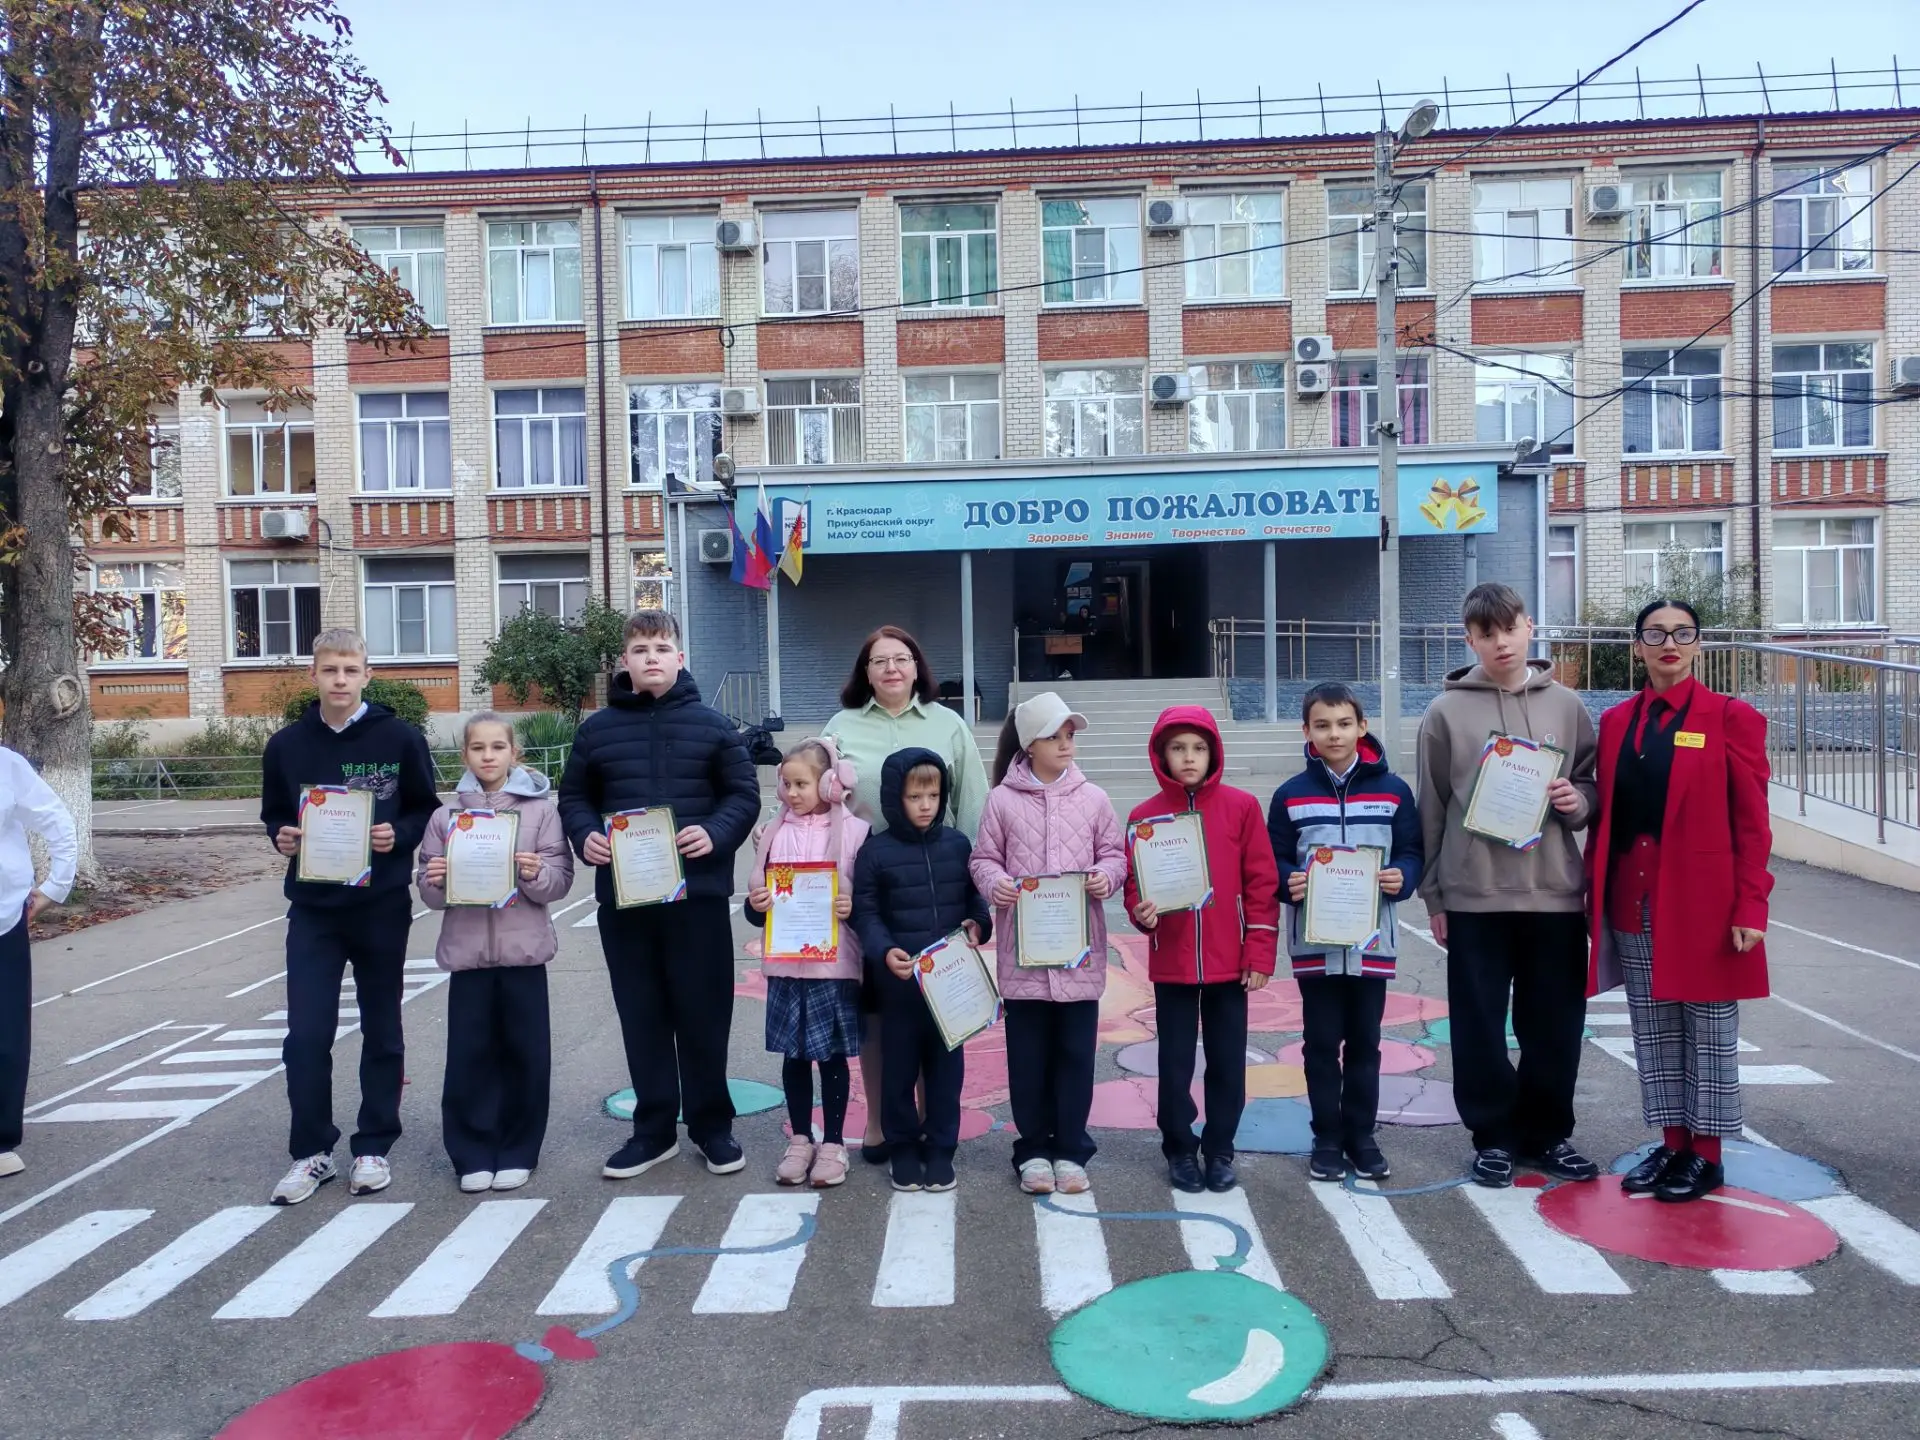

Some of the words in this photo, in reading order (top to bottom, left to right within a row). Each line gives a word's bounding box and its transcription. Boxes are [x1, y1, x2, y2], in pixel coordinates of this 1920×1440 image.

[836, 506, 892, 518] Краснодар
[963, 499, 1090, 530] ДОБРО
[1106, 488, 1379, 522] ПОЖАЛОВАТЬ
[827, 517, 902, 529] Прикубанский
[905, 517, 935, 528] округ
[827, 531, 857, 540] МАОУ
[861, 531, 885, 539] СОШ
[888, 529, 911, 538] №50
[1028, 533, 1089, 544] Здоровье
[1105, 530, 1154, 541] Знание
[1172, 528, 1246, 540] Творчество
[1263, 525, 1332, 536] Отечество
[1501, 760, 1541, 778] ГРАМОТА
[319, 808, 357, 818] ГРАМОТА
[465, 833, 501, 841] ГРАМОТА
[625, 828, 661, 839] ГРАМОТА
[1150, 837, 1189, 849] ГРАМОТА
[1326, 867, 1364, 877] ГРАМОТА
[1033, 892, 1071, 900] ГРАМОТА
[934, 956, 966, 979] ГРАМОТА
